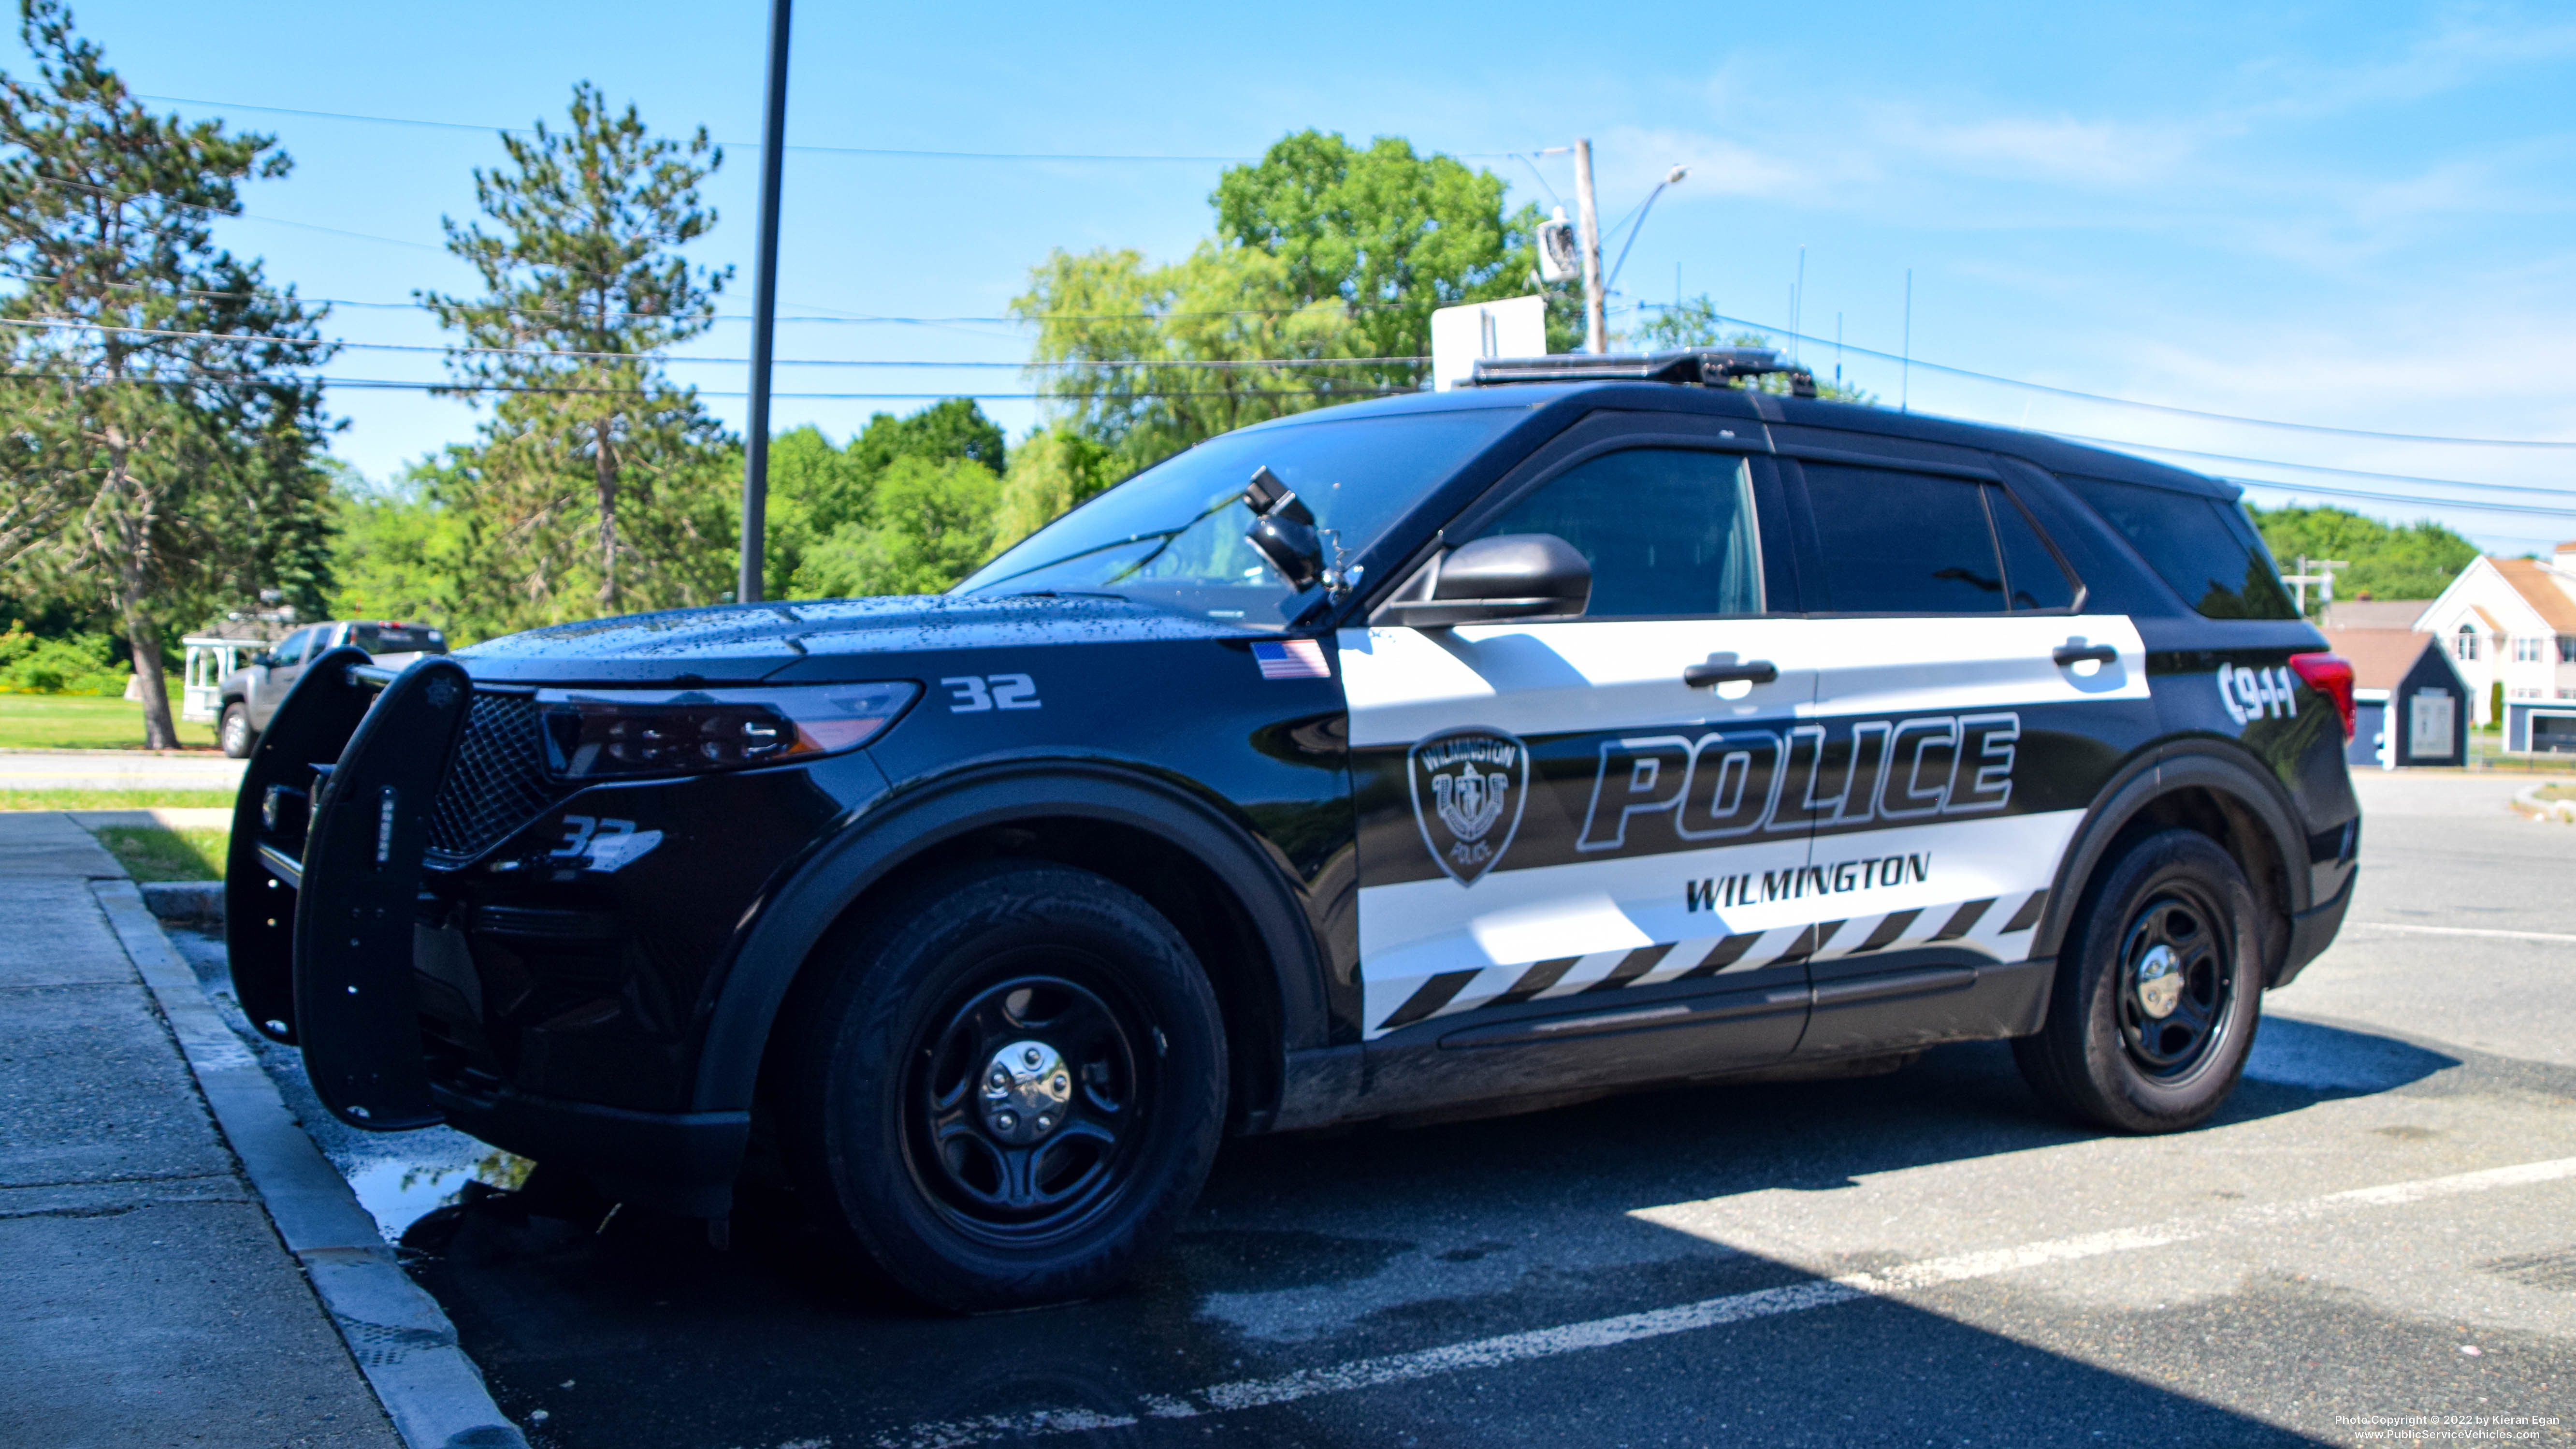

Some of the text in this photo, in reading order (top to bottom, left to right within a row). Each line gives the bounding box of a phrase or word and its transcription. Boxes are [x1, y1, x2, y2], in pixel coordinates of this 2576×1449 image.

[941, 673, 1042, 713] 32
[1420, 738, 1516, 773] WILMINGTON
[1576, 712, 2020, 851] POLICE
[1449, 840, 1492, 865] POLICE
[1686, 851, 1931, 913] WILMINGTON
